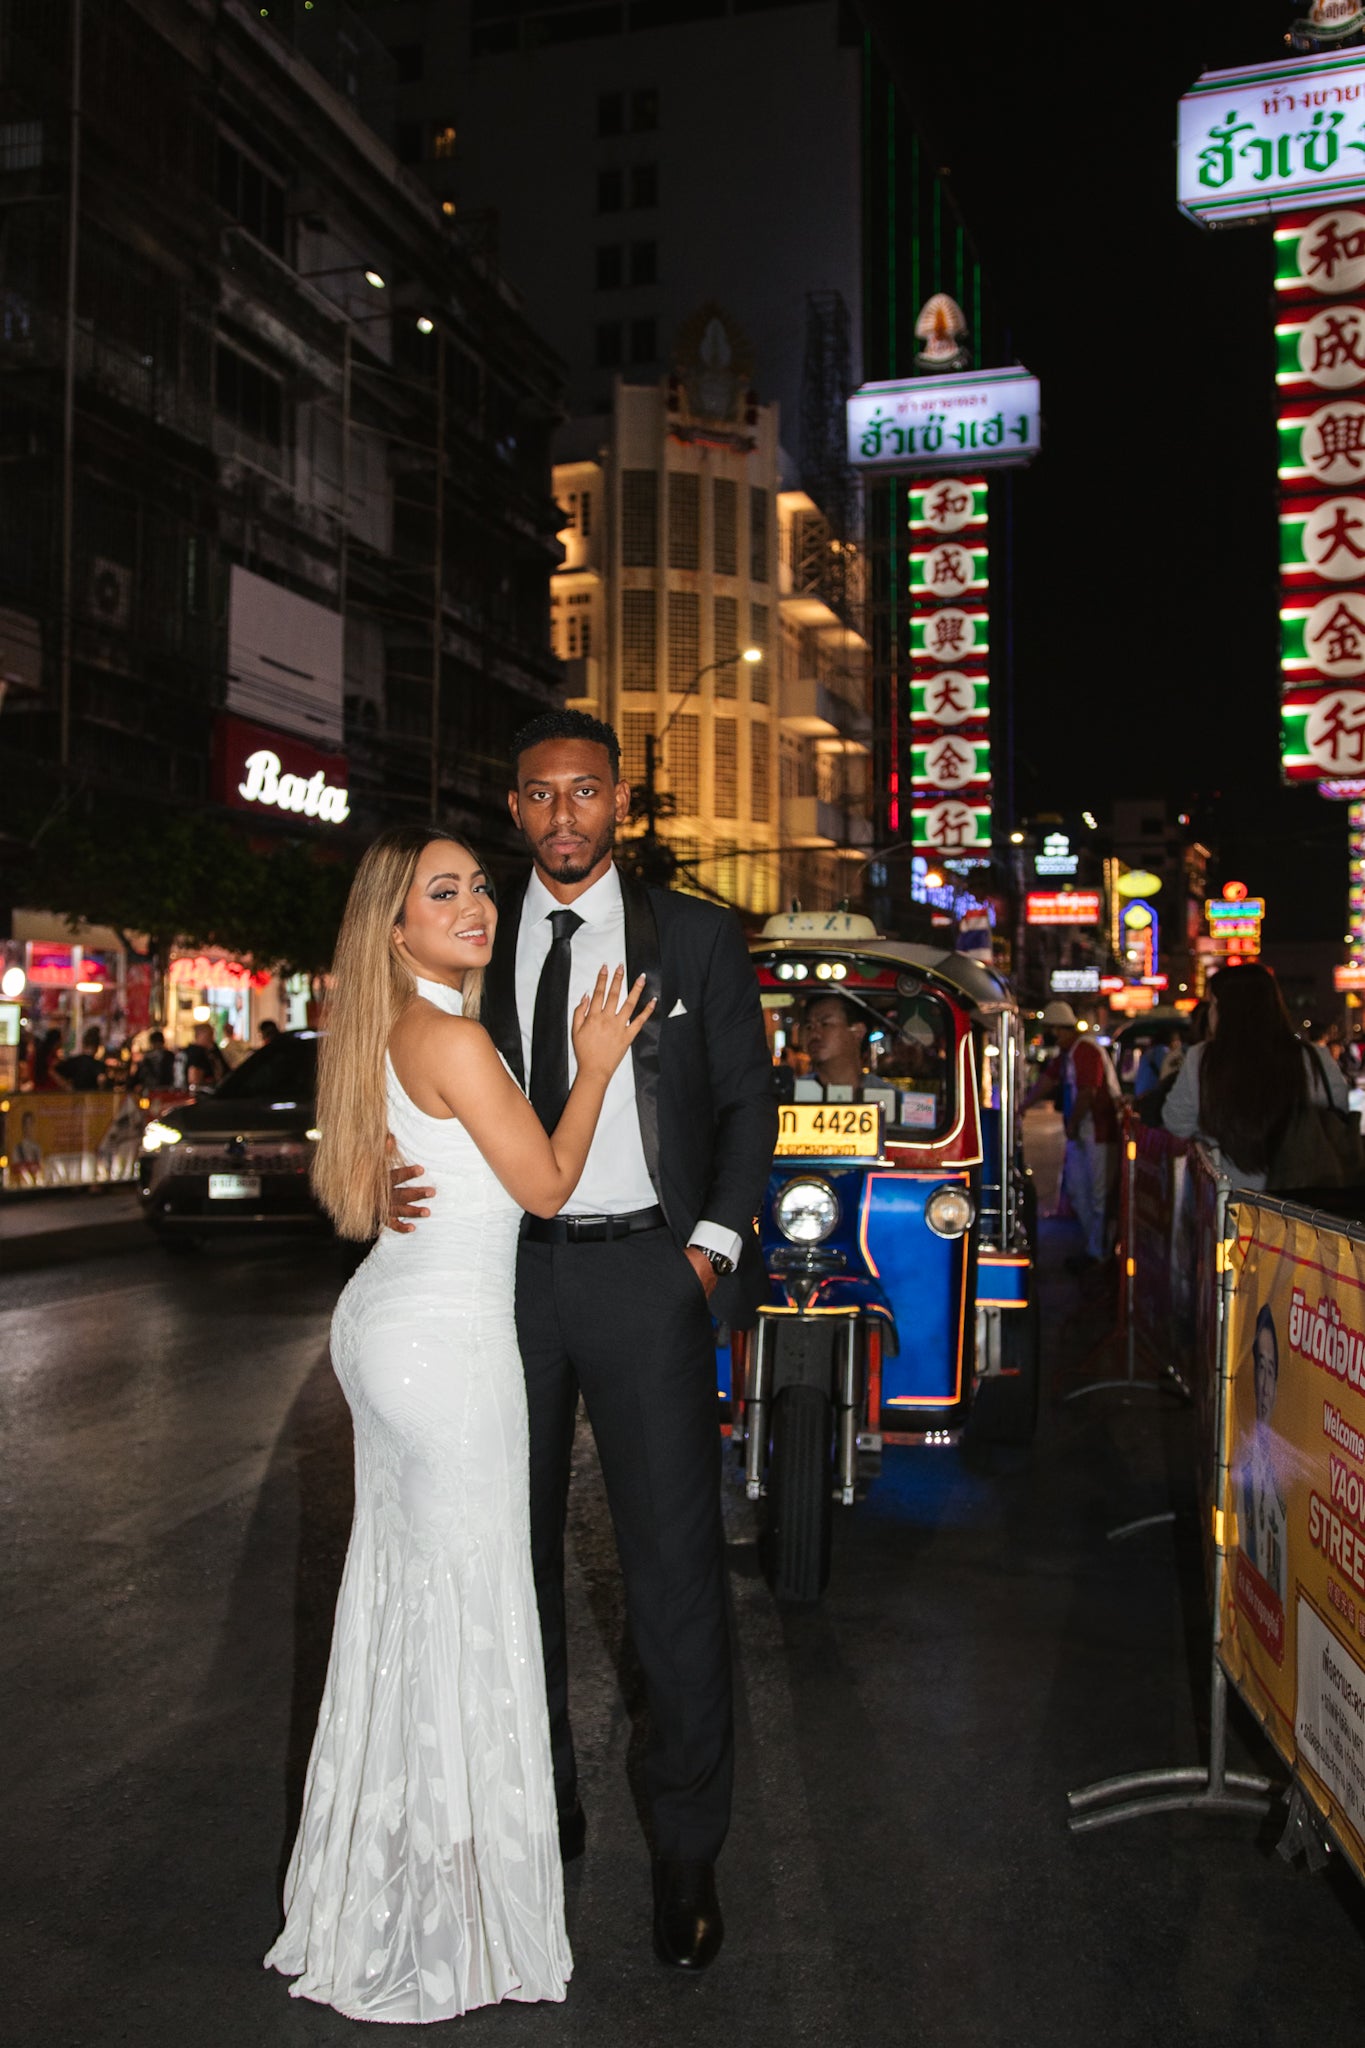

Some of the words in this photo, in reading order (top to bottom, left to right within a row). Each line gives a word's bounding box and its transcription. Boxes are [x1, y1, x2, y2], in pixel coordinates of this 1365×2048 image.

[930, 487, 970, 847] 和成興大金行
[238, 749, 351, 824] Bata
[813, 1110, 873, 1133] 4426
[1324, 1403, 1364, 1460] Welcome
